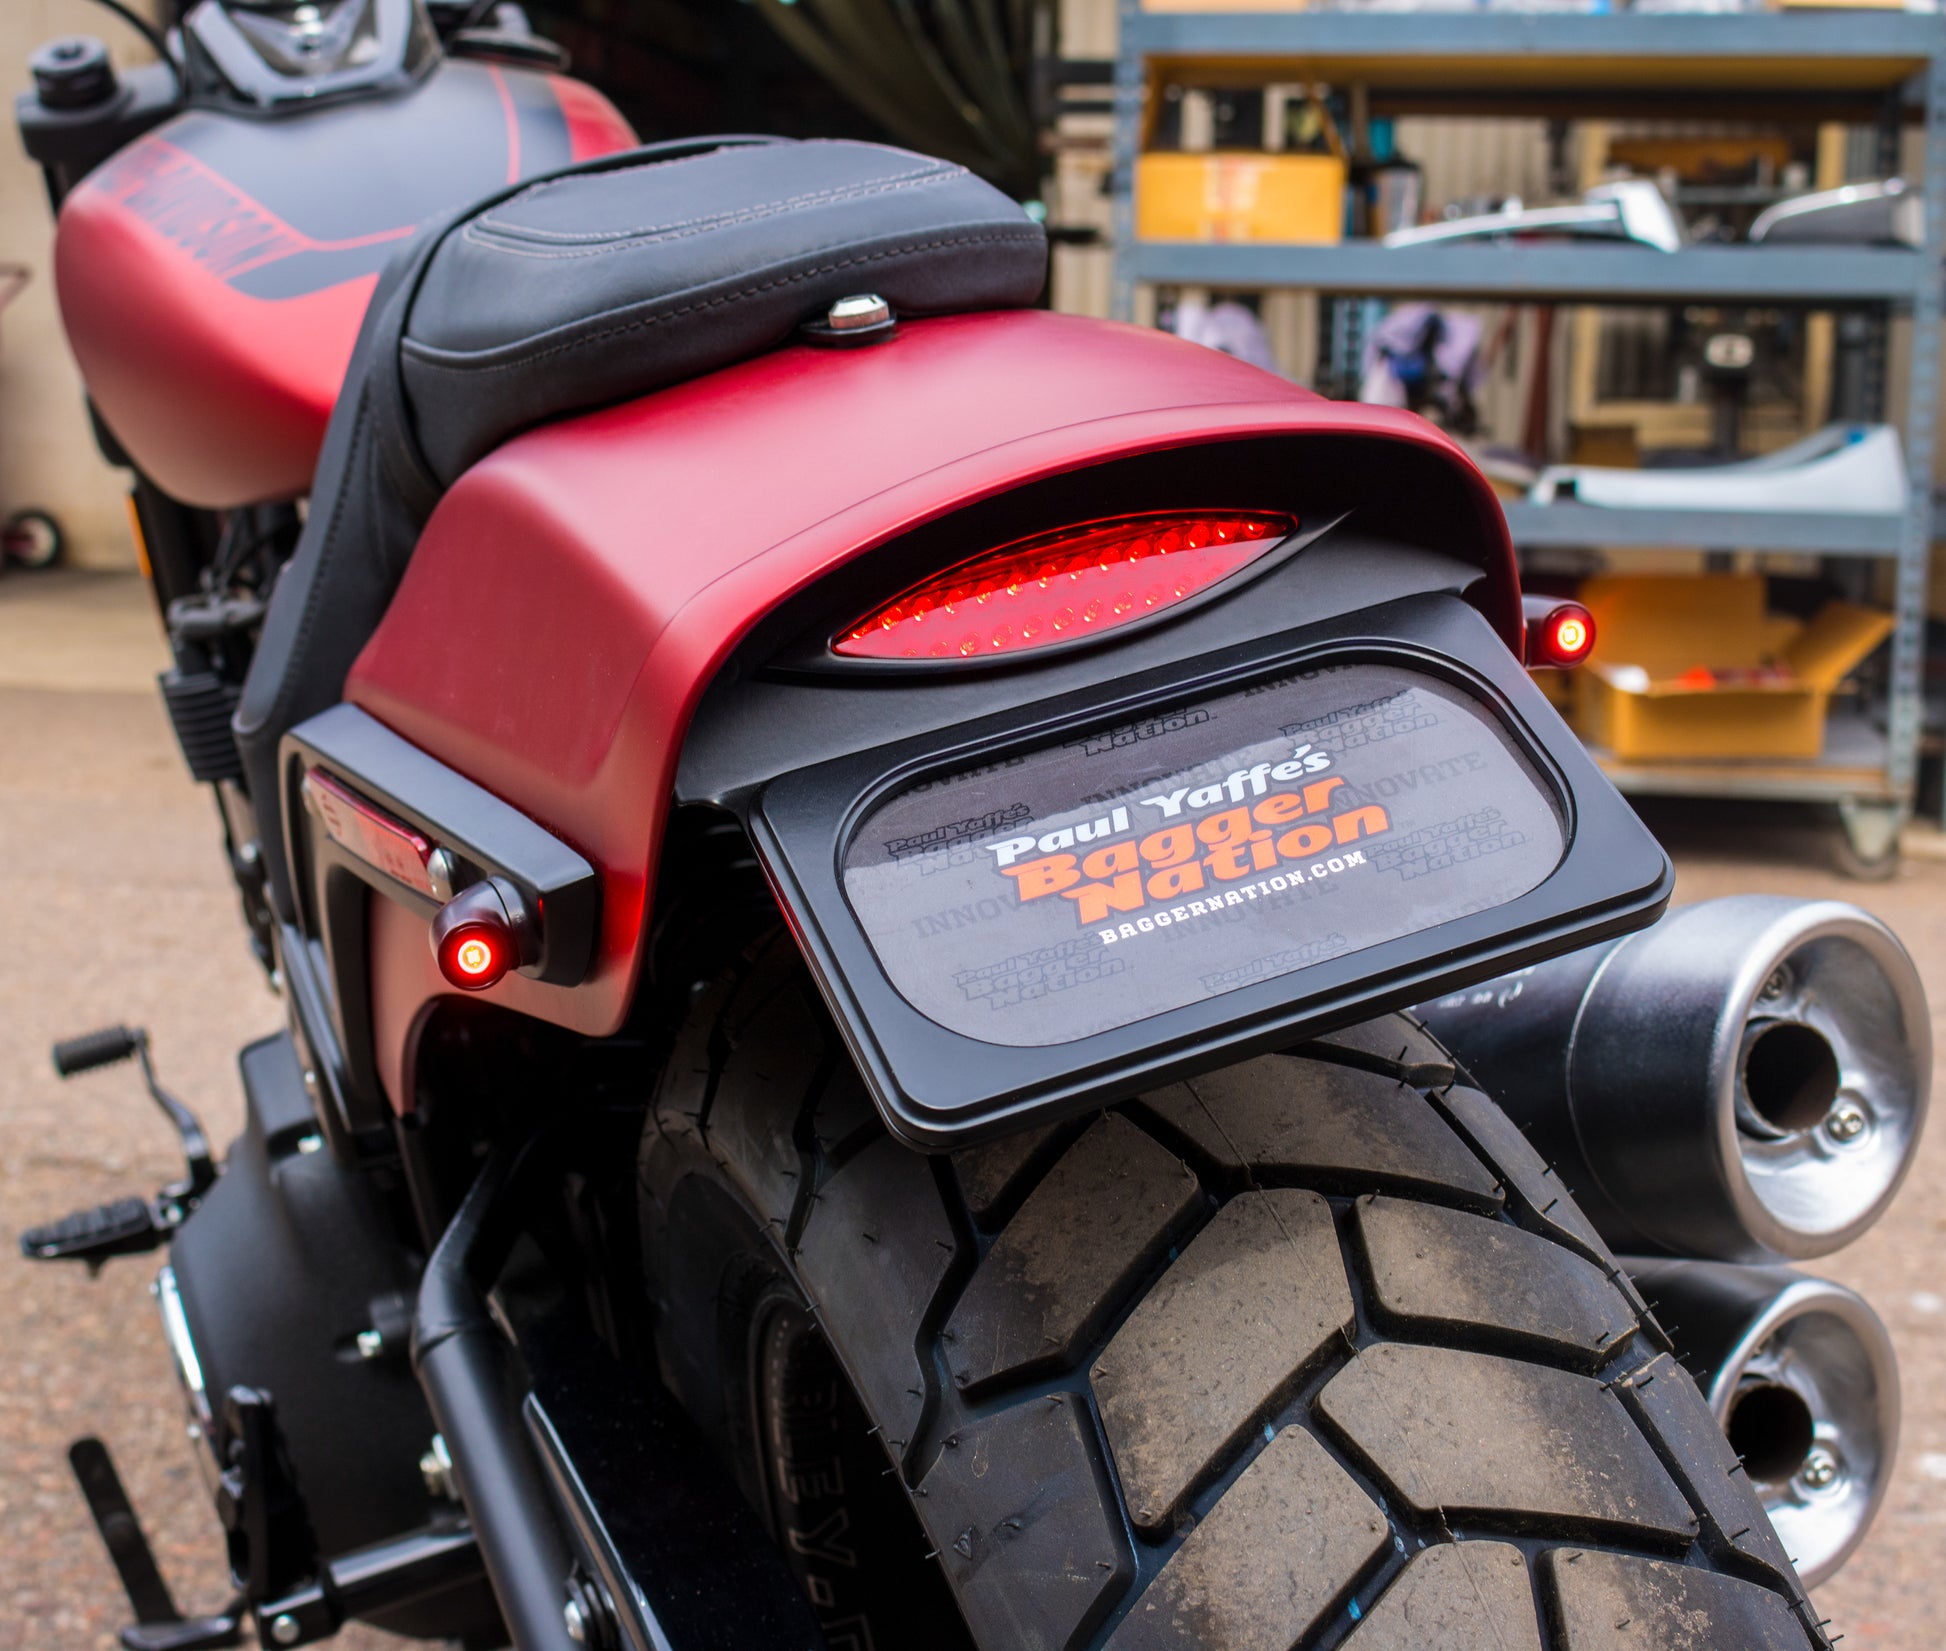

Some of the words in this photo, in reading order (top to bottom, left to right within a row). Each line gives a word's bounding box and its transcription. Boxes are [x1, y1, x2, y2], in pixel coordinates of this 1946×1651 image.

[1278, 706, 1338, 737] Paul
[884, 826, 946, 851] Paul
[984, 806, 1130, 867] Paul
[1000, 777, 1344, 902] Bagger
[1363, 829, 1422, 856] Paul
[1367, 819, 1508, 873] Bagger
[1394, 830, 1526, 882] Nation
[1060, 805, 1389, 925] Nation
[911, 892, 1026, 938] INNOV
[1098, 850, 1367, 945] BAGGERNATION.COM
[952, 957, 1016, 983] Paul
[958, 944, 1110, 1001] Bagger
[984, 957, 1126, 1011] Nation
[1200, 959, 1263, 988] Paul
